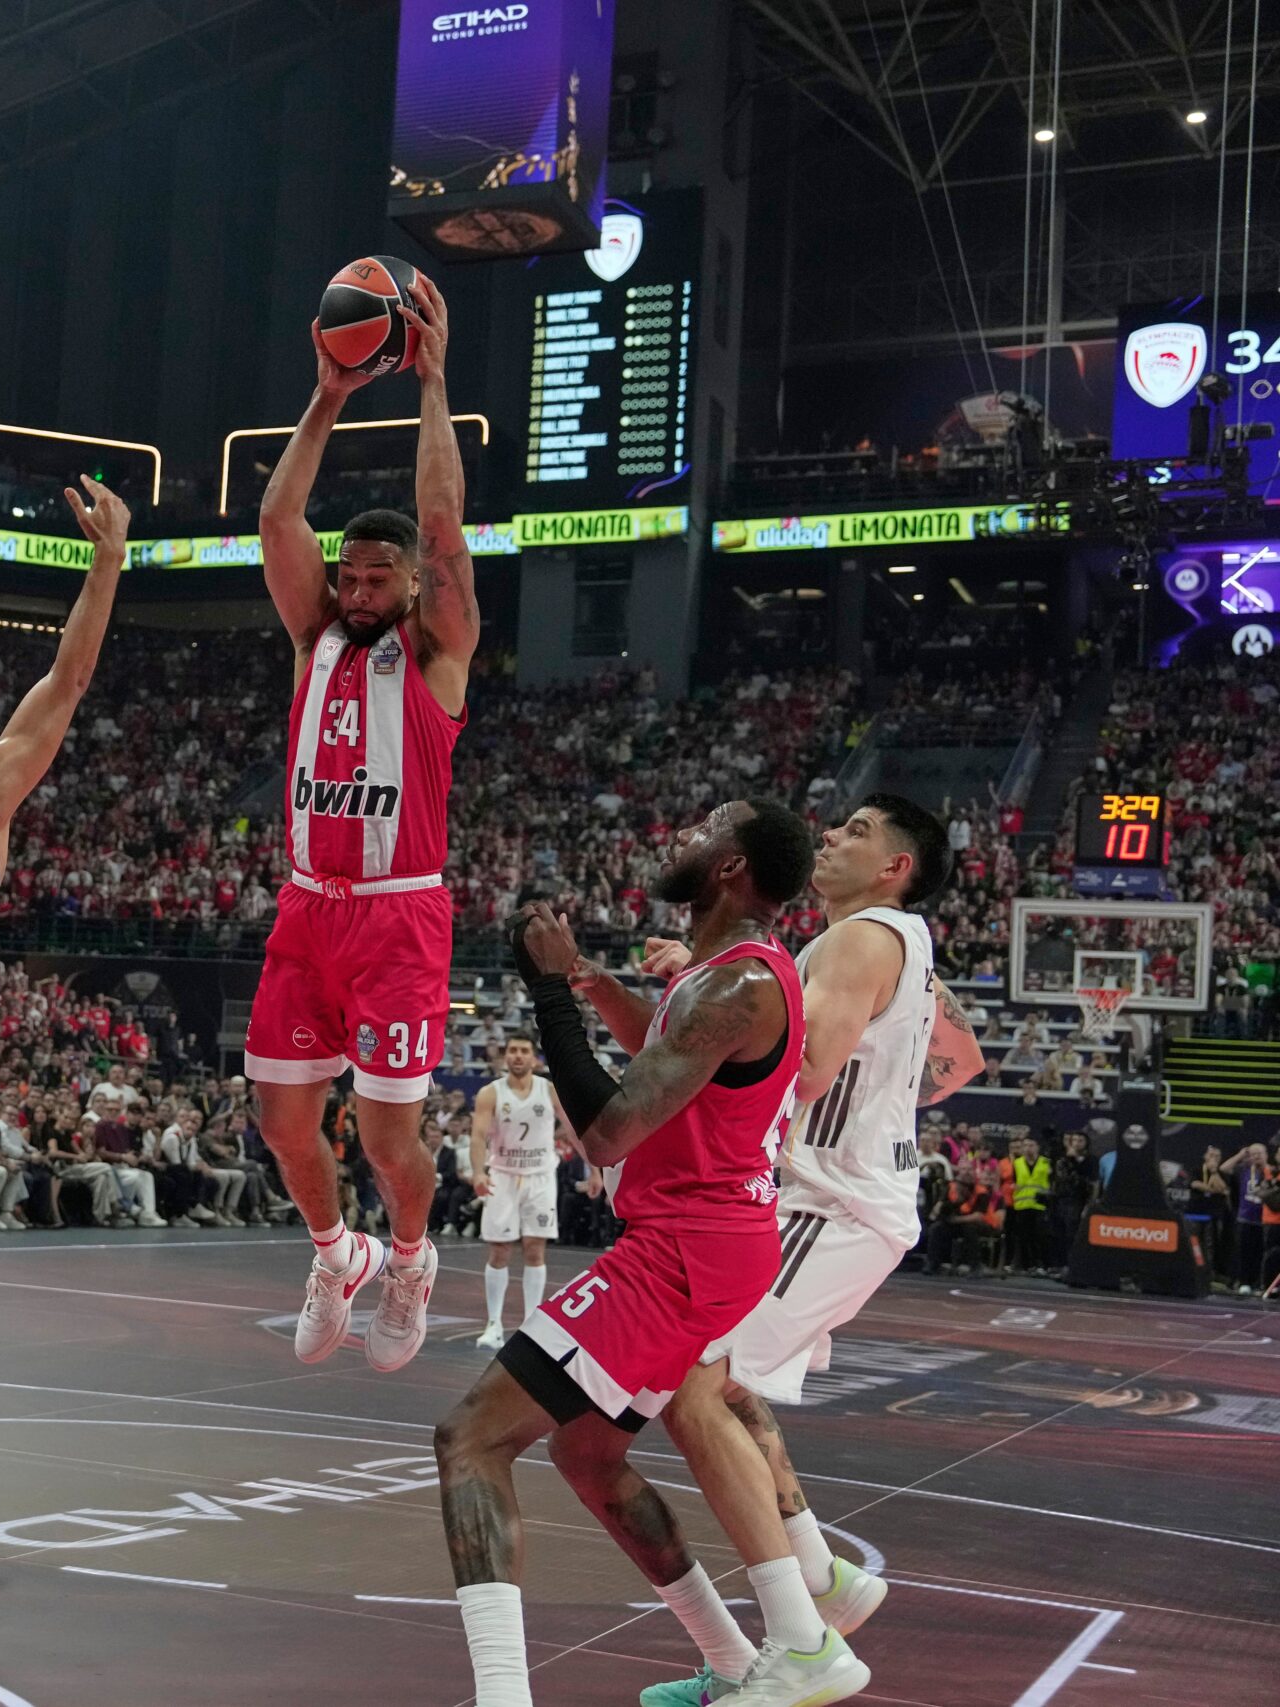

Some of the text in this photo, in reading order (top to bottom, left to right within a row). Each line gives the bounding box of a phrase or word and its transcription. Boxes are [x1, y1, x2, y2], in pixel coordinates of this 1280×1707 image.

[432, 4, 528, 31] ETIHAD
[431, 21, 528, 43] BEYOND BORDERS
[323, 699, 361, 748] 34
[294, 766, 400, 818] bwin
[1099, 795, 1161, 820] 3:29
[1104, 824, 1151, 861] 10
[519, 1122, 529, 1141] 7
[1098, 1222, 1169, 1243] trendyol
